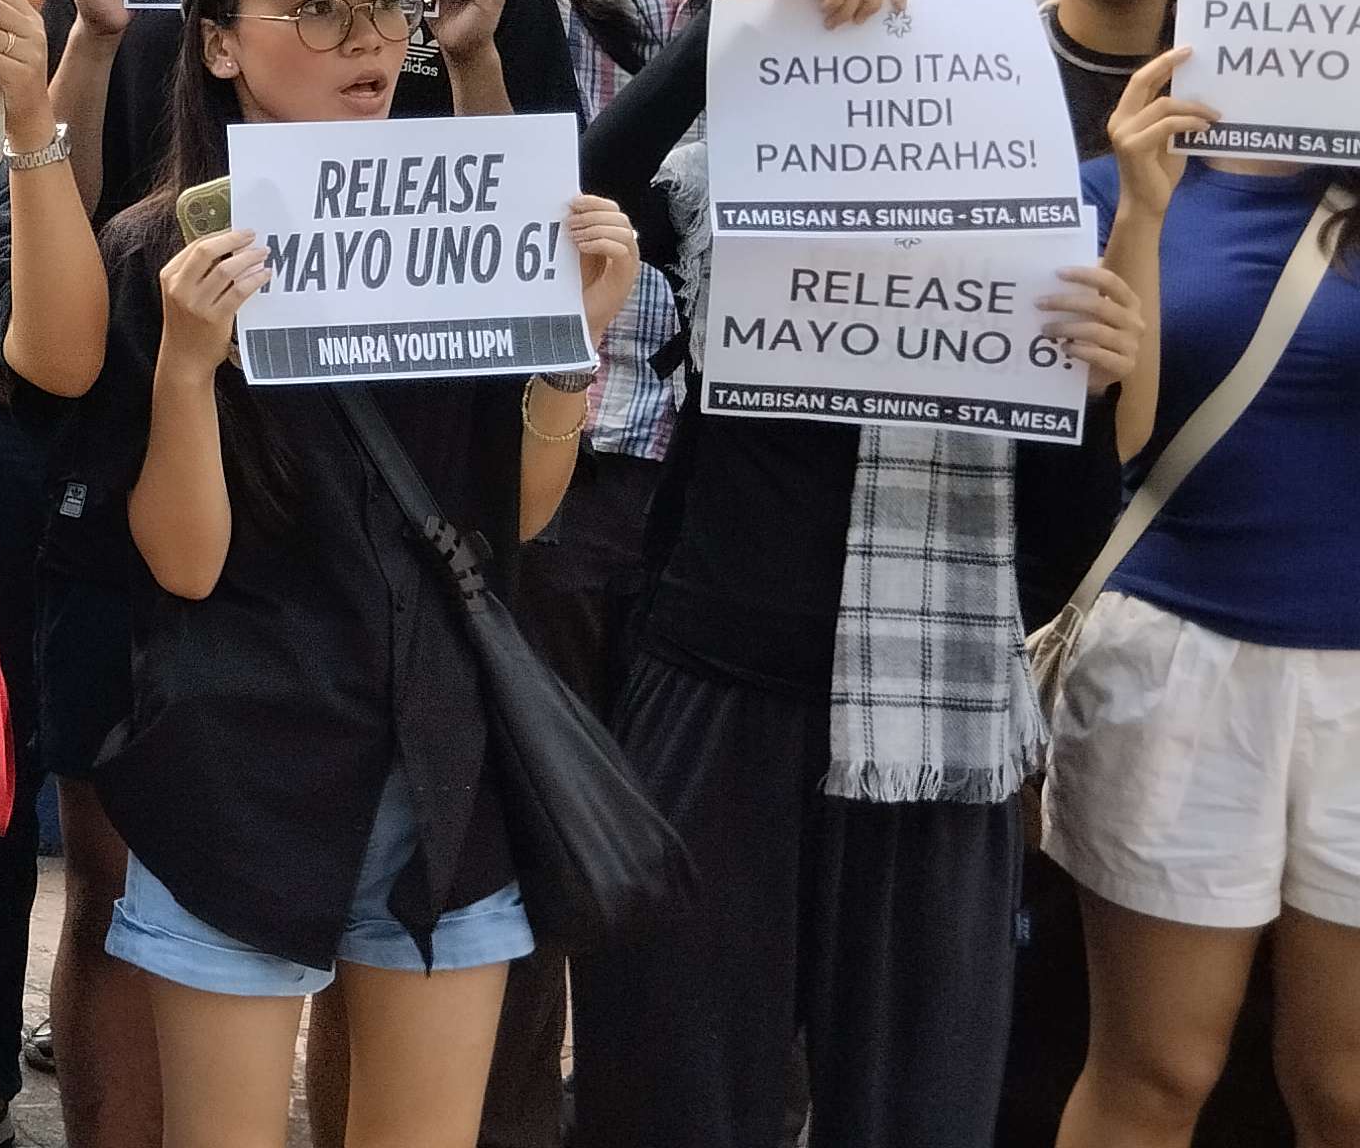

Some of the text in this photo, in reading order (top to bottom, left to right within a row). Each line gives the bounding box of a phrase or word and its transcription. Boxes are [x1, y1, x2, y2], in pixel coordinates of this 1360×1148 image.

[758, 52, 1022, 86] SAHOD ITAAS,
[1217, 46, 1350, 81] MAYO
[846, 98, 954, 129] HINDI
[755, 139, 1037, 173] PANDARAHAS!
[1184, 129, 1327, 152] TAMBISAN SA
[313, 153, 504, 220] RELEASE
[722, 206, 1076, 227] TAMBISAN SA SINING STA. MESA
[260, 222, 560, 293] MAYO UNO 6!
[790, 268, 1017, 315] RELEASE
[318, 329, 514, 365] NNARA YOUTH UPM
[722, 315, 1012, 365] MAYO UNO
